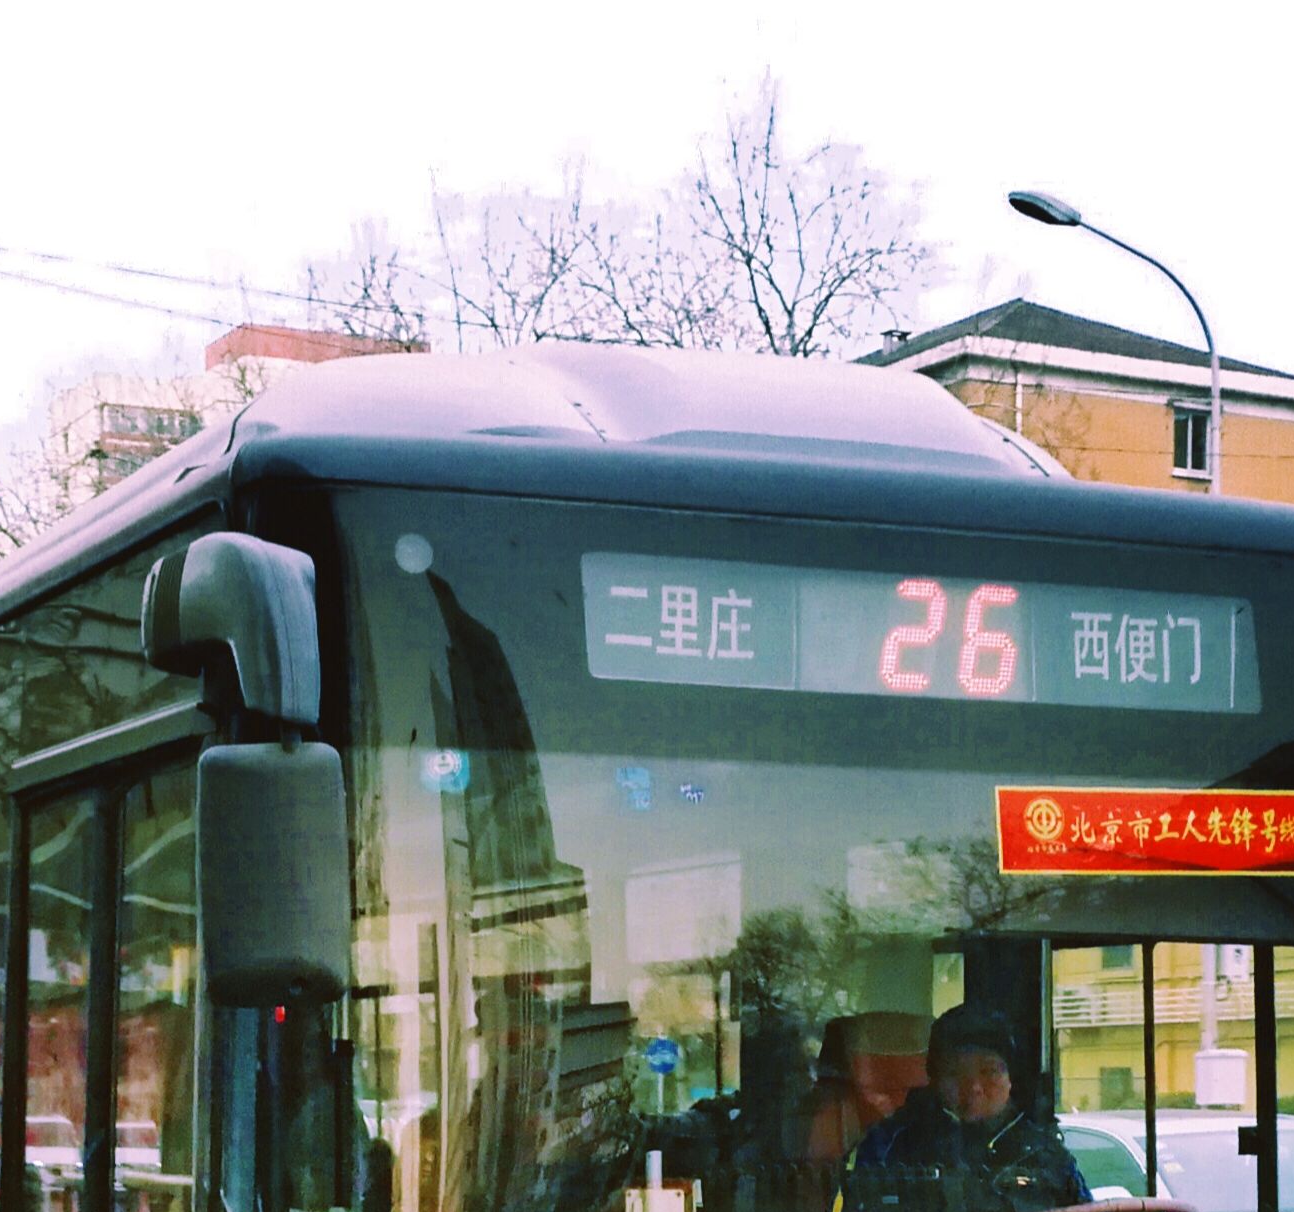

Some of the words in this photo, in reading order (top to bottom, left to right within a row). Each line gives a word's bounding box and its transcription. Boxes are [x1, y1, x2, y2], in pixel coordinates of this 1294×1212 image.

[605, 584, 755, 660] 二里庄
[879, 576, 1020, 696] 26
[1070, 610, 1203, 686] 西便门
